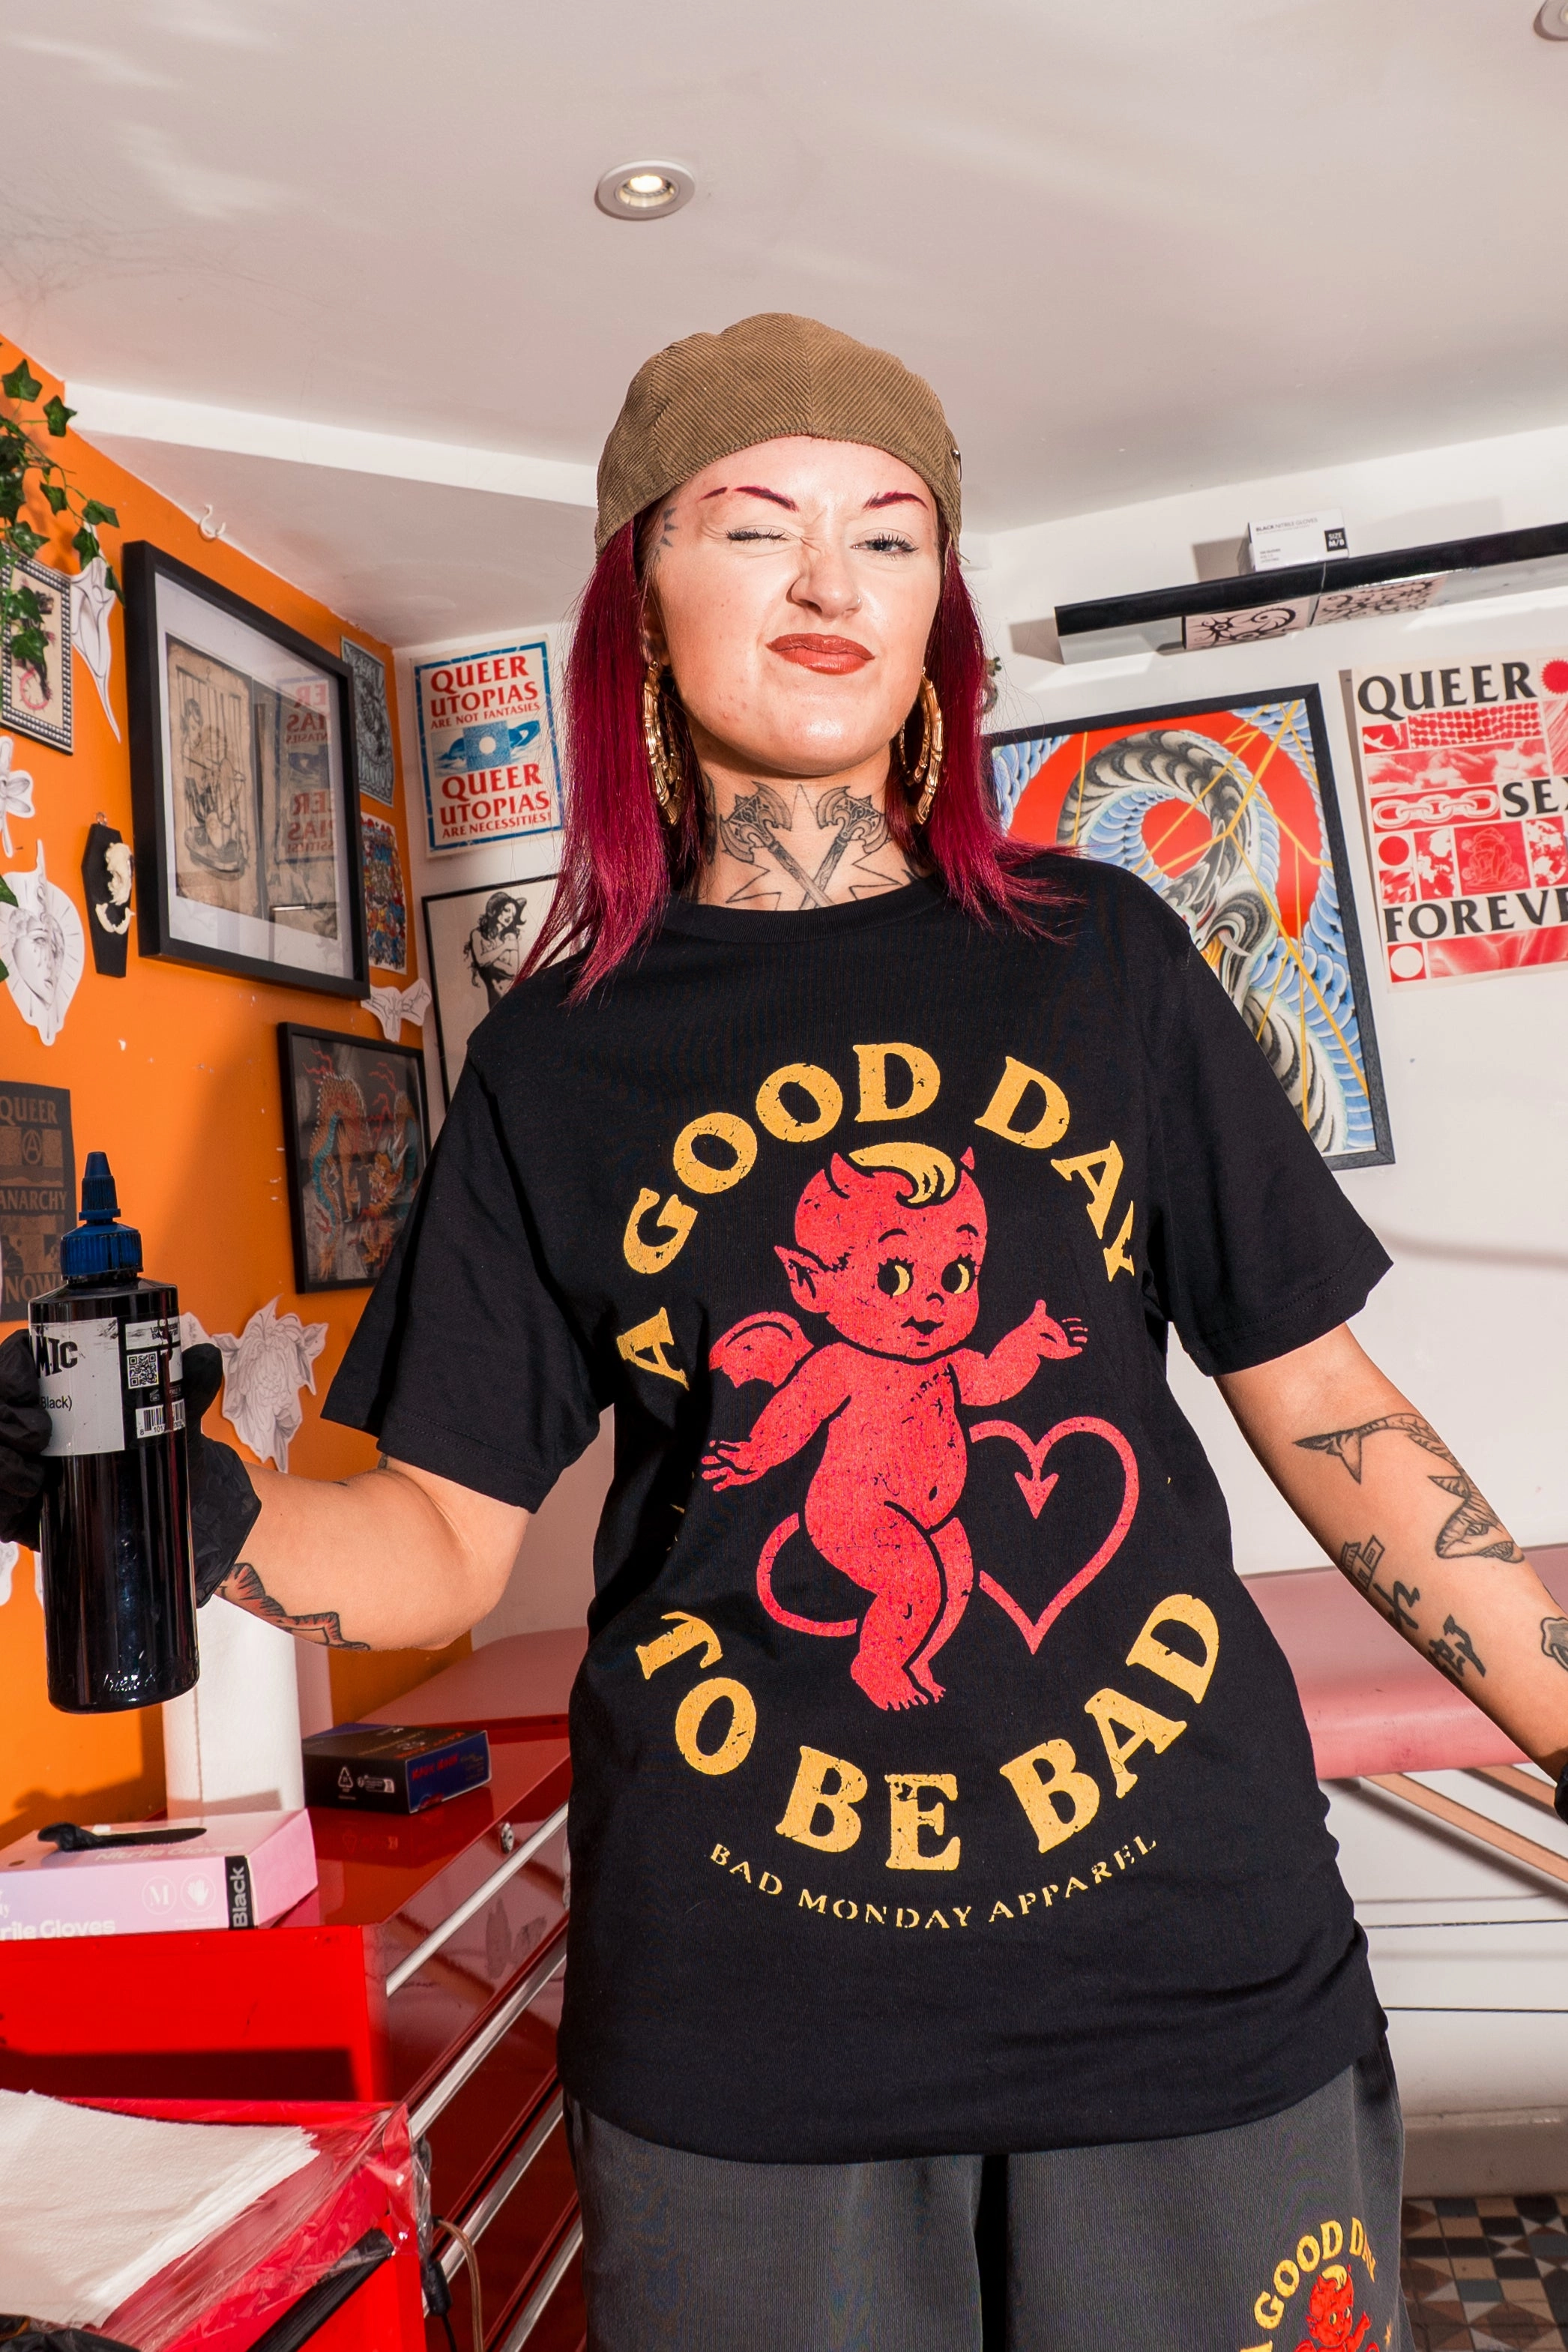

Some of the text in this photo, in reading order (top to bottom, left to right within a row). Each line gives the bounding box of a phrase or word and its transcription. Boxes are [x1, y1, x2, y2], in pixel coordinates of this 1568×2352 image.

[1328, 531, 1343, 540] SIZE
[430, 655, 529, 694] QUEER
[1357, 661, 1538, 721] QUEER
[430, 681, 539, 717] UTOPIAS
[430, 702, 540, 730] ARE NOT FANTASIES
[441, 762, 543, 802] QUEER
[439, 791, 550, 826] UTOPIAS
[442, 811, 551, 839] ARE NECESSITIES!
[0, 1096, 58, 1126] QUEER
[622, 1042, 941, 1275] GOOD
[0, 1190, 67, 1211] ANARCHY
[618, 1306, 690, 1391] A
[636, 1593, 1219, 1872] TO BE BAD
[149, 1885, 170, 1907] M
[229, 1866, 249, 1928] Black
[711, 1836, 1157, 1929] BAD MONDAY APPAREL
[40, 1919, 115, 1938] Gloves
[1254, 2220, 1343, 2330] GOOD
